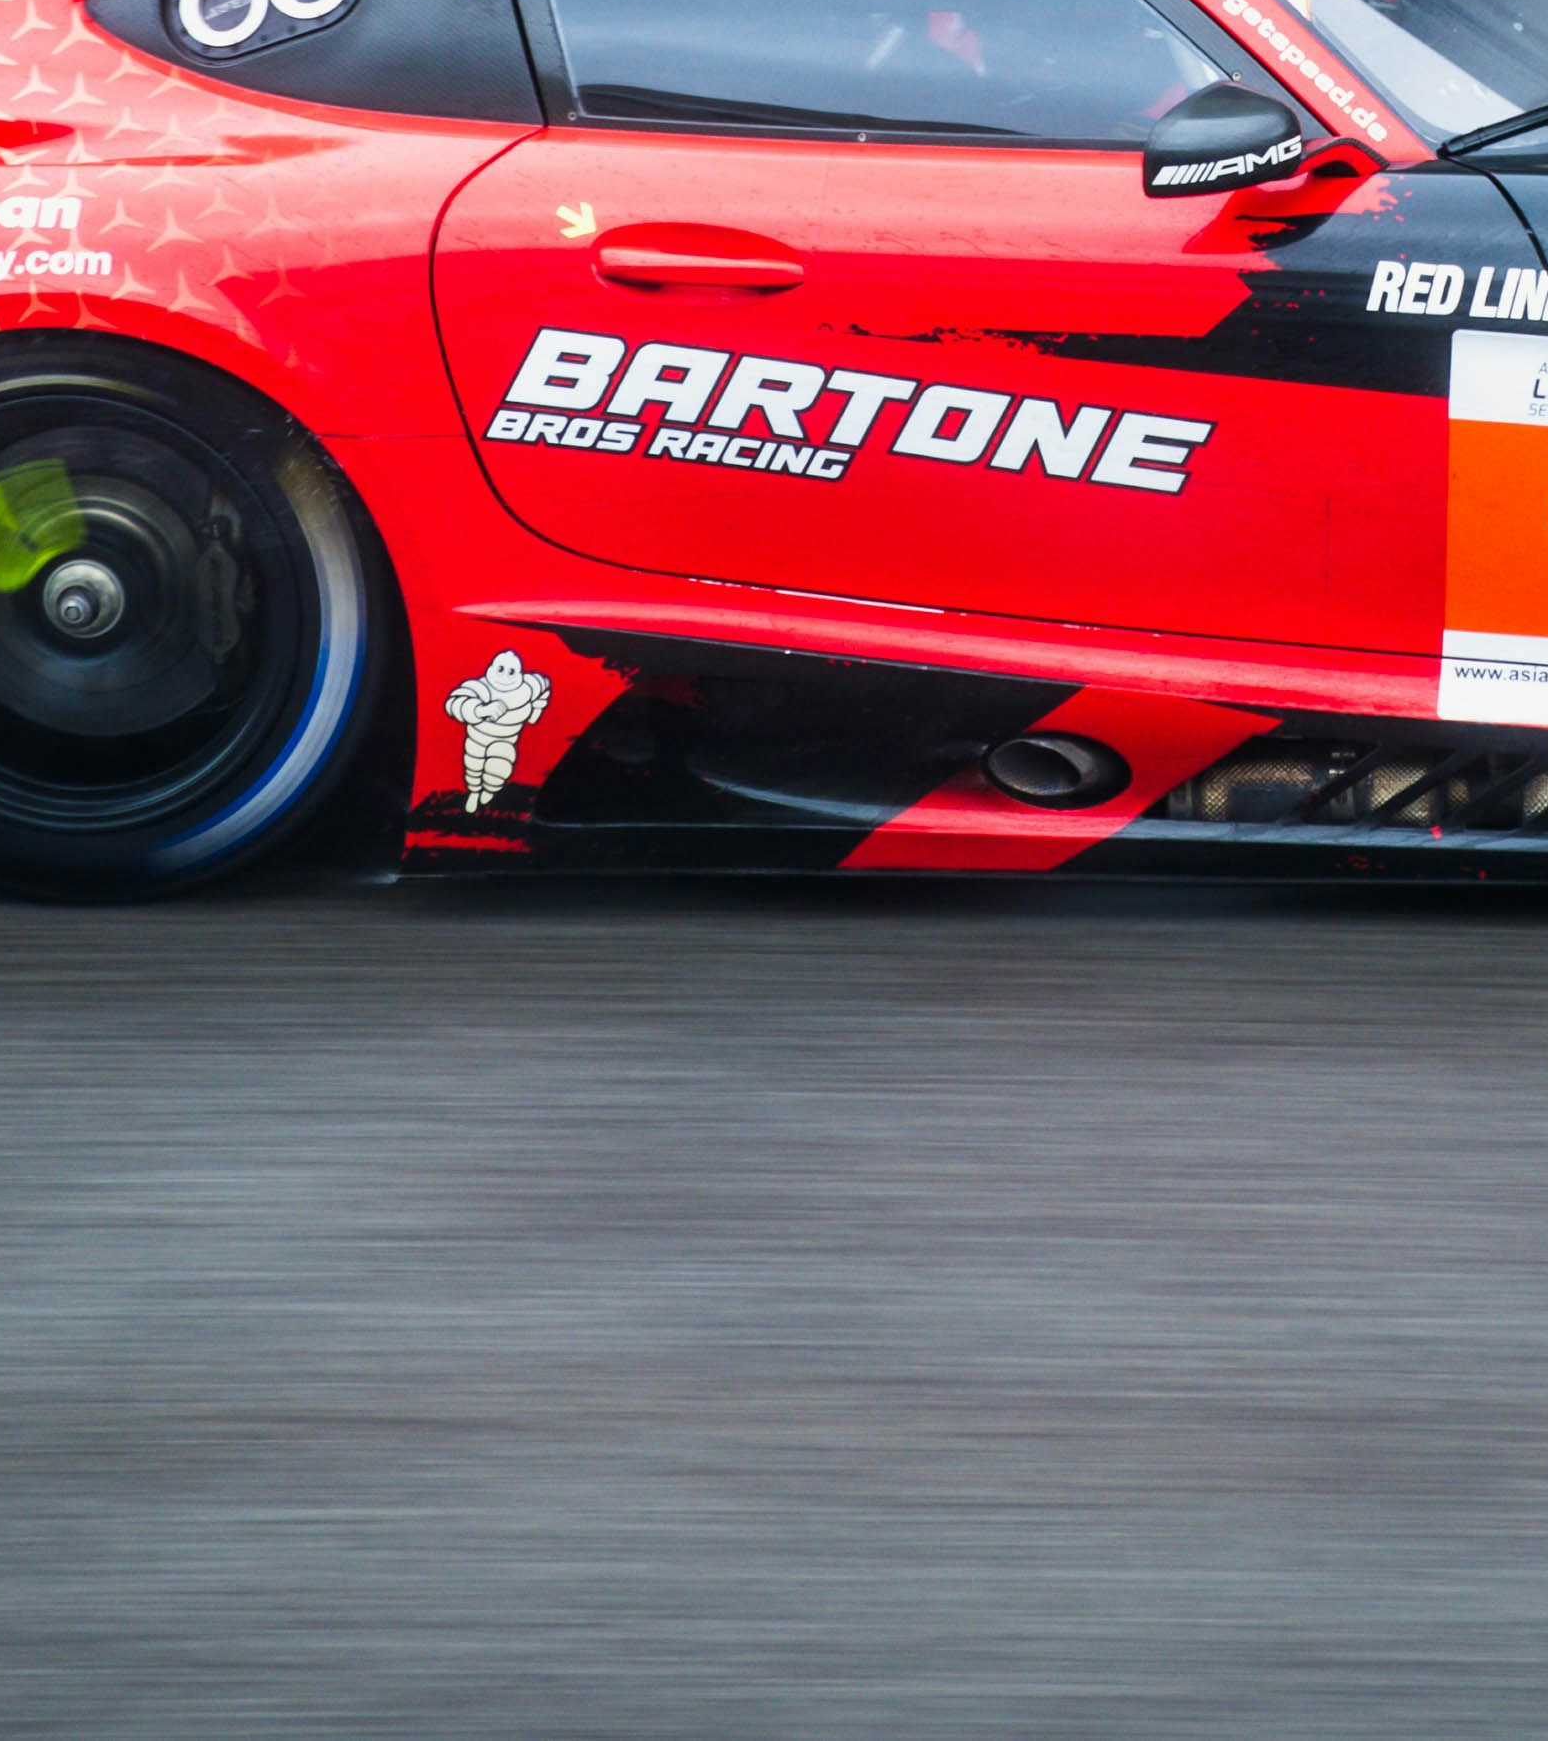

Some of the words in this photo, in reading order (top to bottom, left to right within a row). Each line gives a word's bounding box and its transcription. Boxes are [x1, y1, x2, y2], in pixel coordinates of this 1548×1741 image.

[1208, 134, 1303, 181] AMG
[1366, 259, 1465, 316] RED
[504, 326, 1216, 495] BARTONE
[486, 408, 645, 454] BROS
[648, 425, 852, 484] RACING
